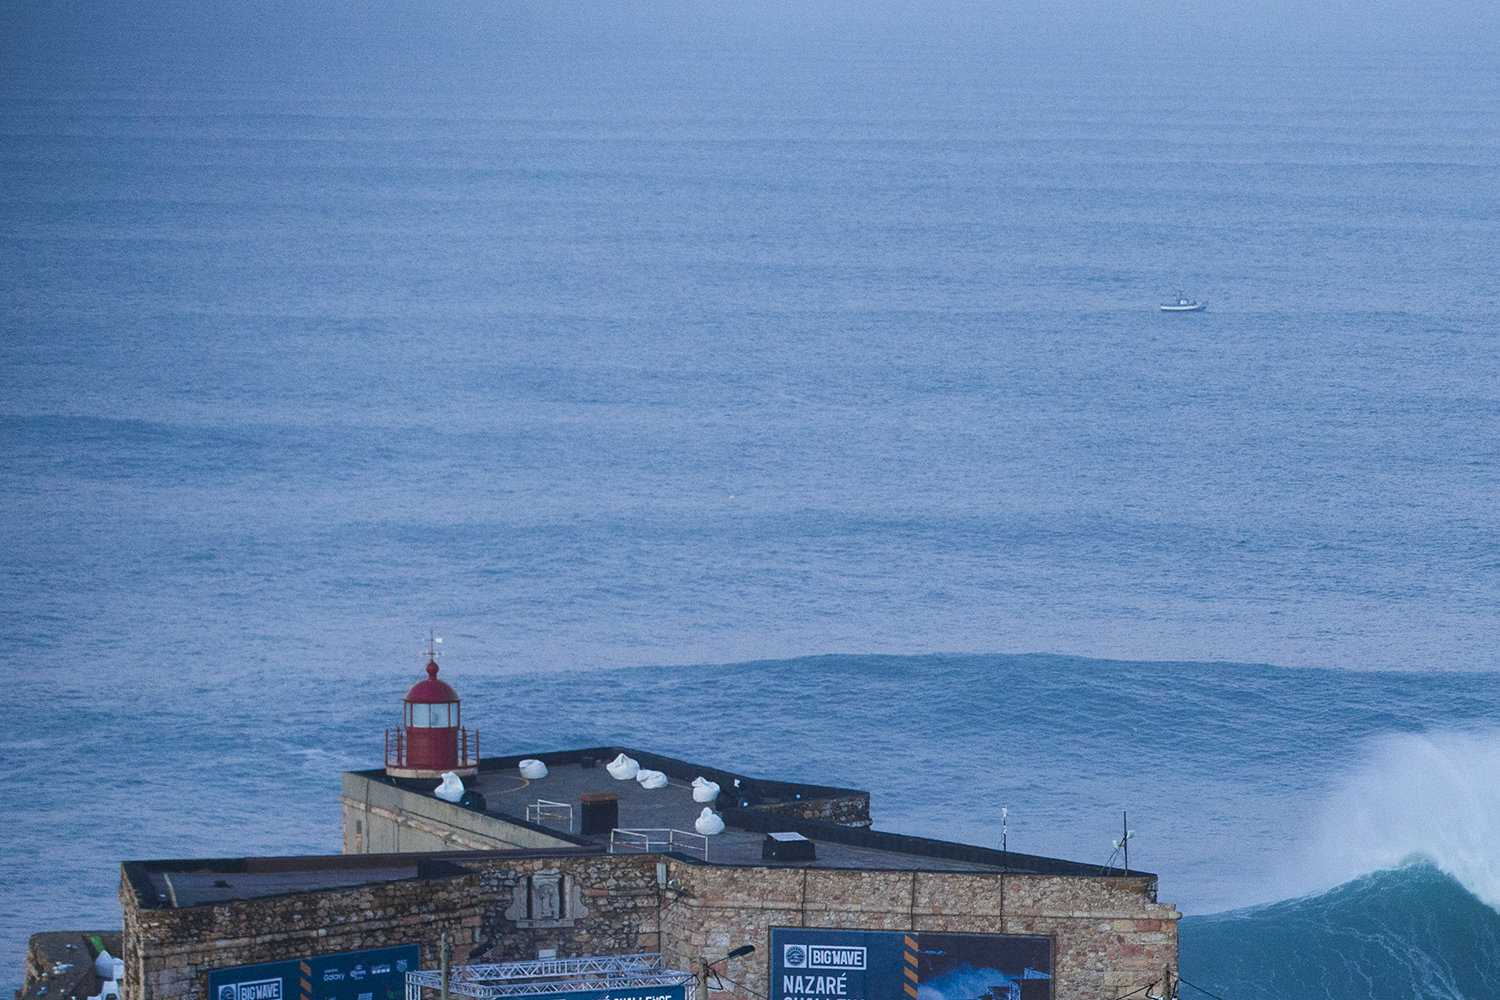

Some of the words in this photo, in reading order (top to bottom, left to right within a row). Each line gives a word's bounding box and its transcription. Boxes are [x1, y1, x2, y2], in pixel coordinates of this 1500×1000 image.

[813, 950, 831, 964] BIG
[832, 950, 862, 965] WAVE
[241, 986, 256, 1000] BIG
[256, 983, 279, 1000] WAVE
[783, 972, 847, 995] NAZARÉ
